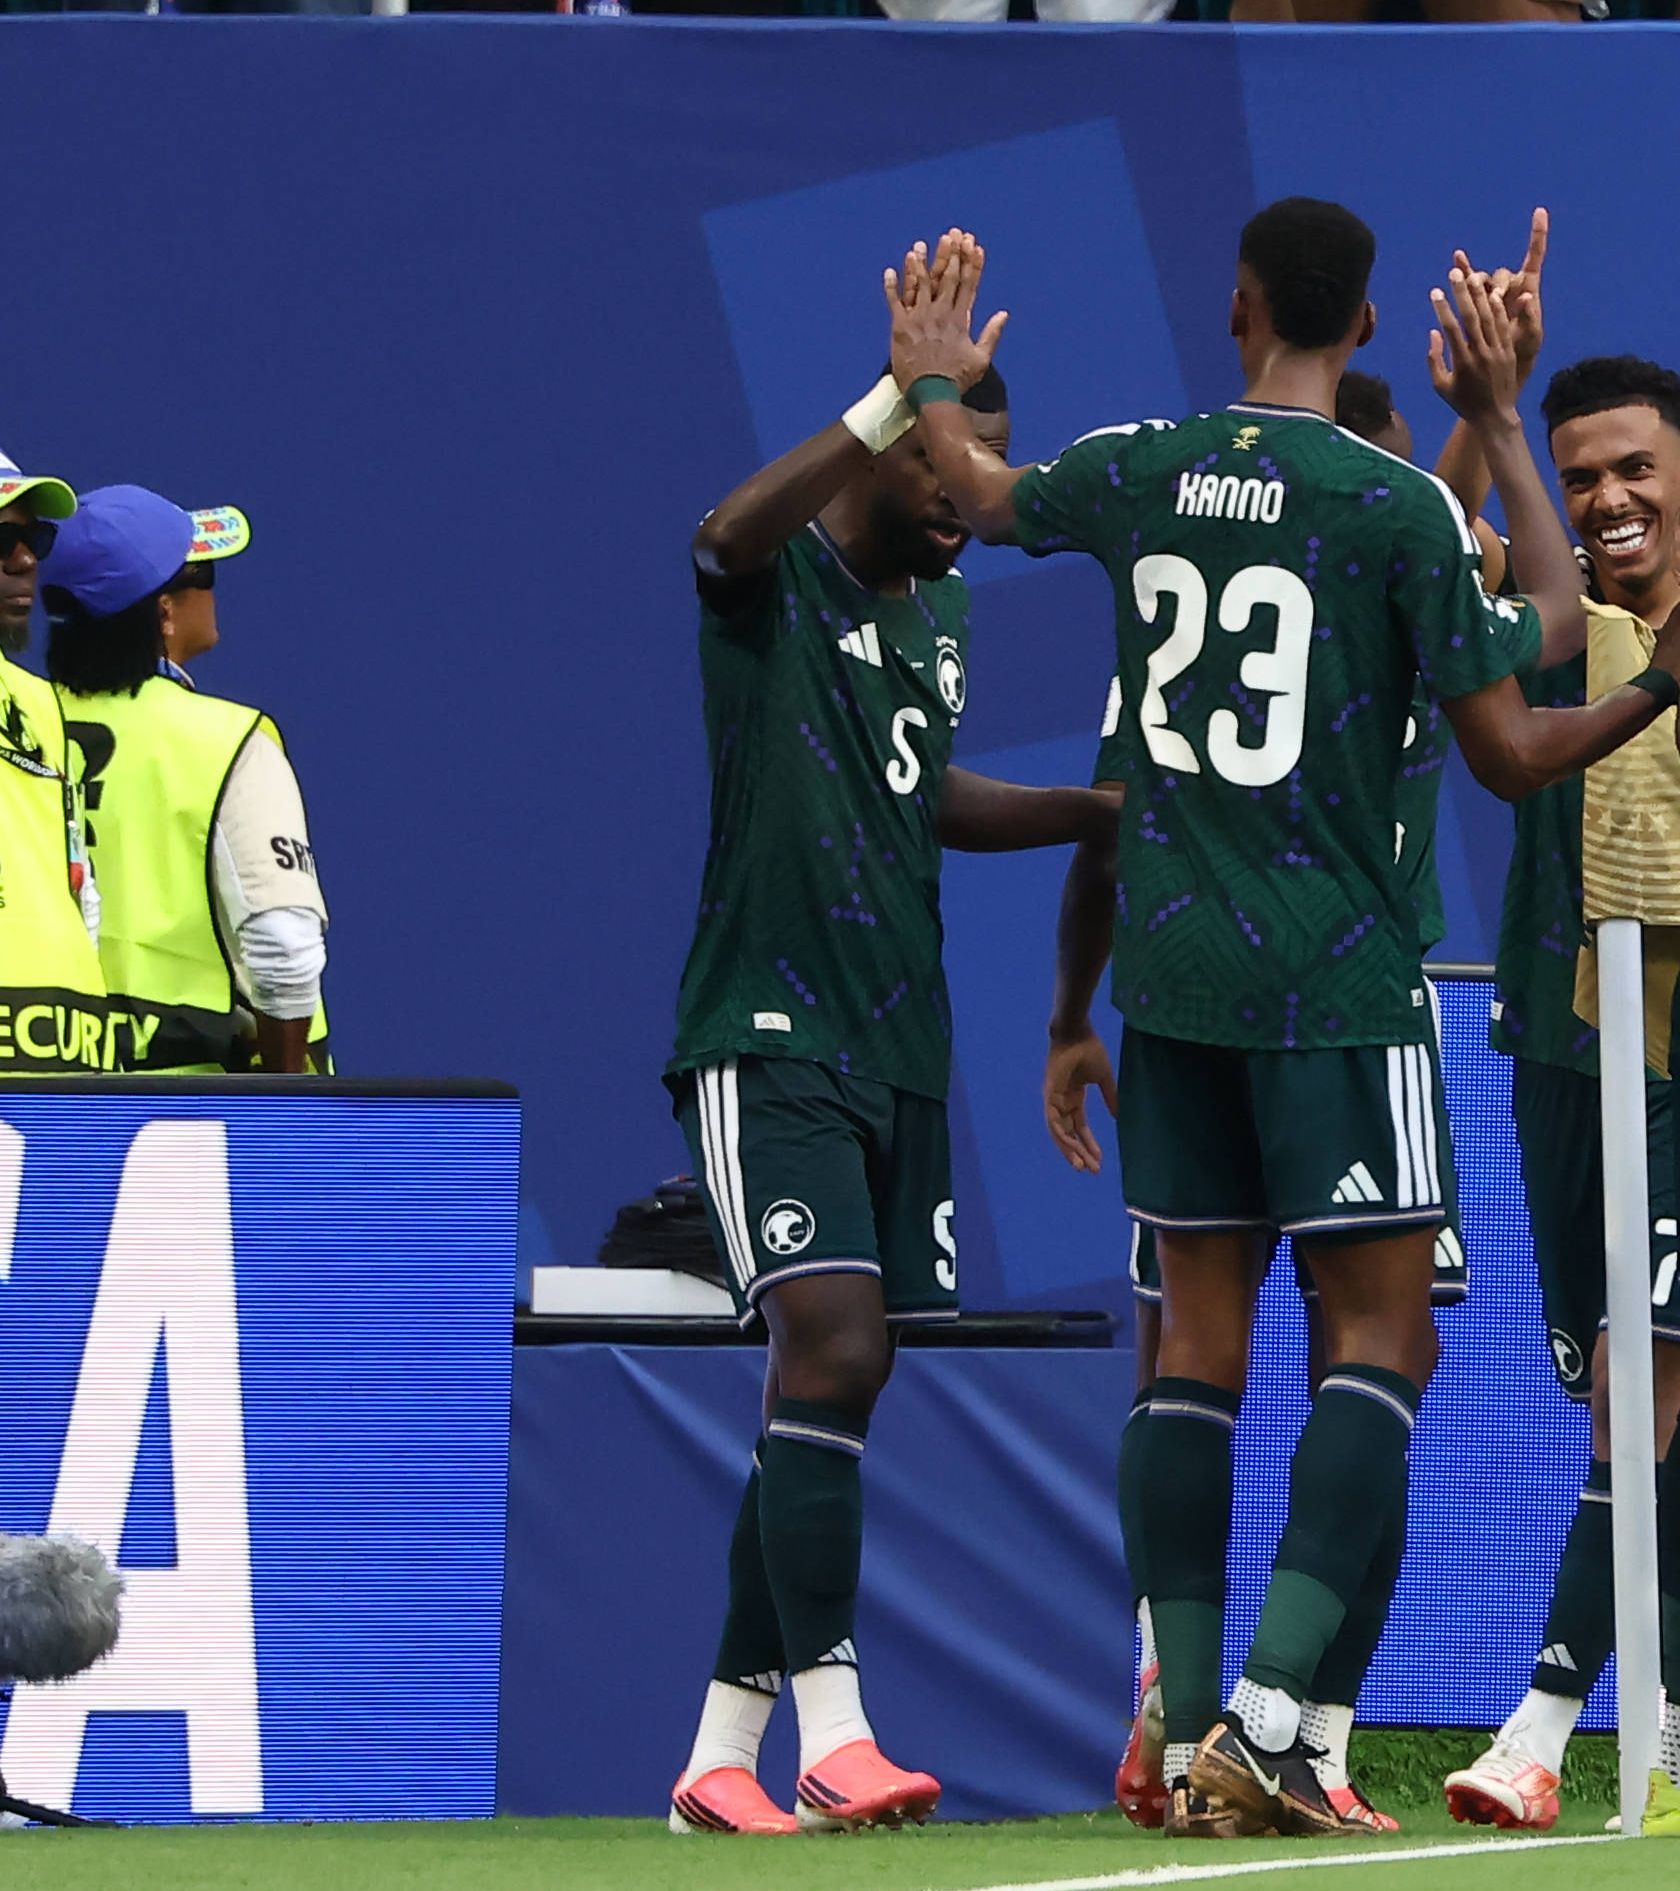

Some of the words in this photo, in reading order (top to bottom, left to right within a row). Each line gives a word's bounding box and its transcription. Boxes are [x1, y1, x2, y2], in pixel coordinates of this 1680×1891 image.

[1175, 471, 1284, 524] KANNO
[1132, 553, 1314, 787] 23
[0, 1119, 264, 1815] A
